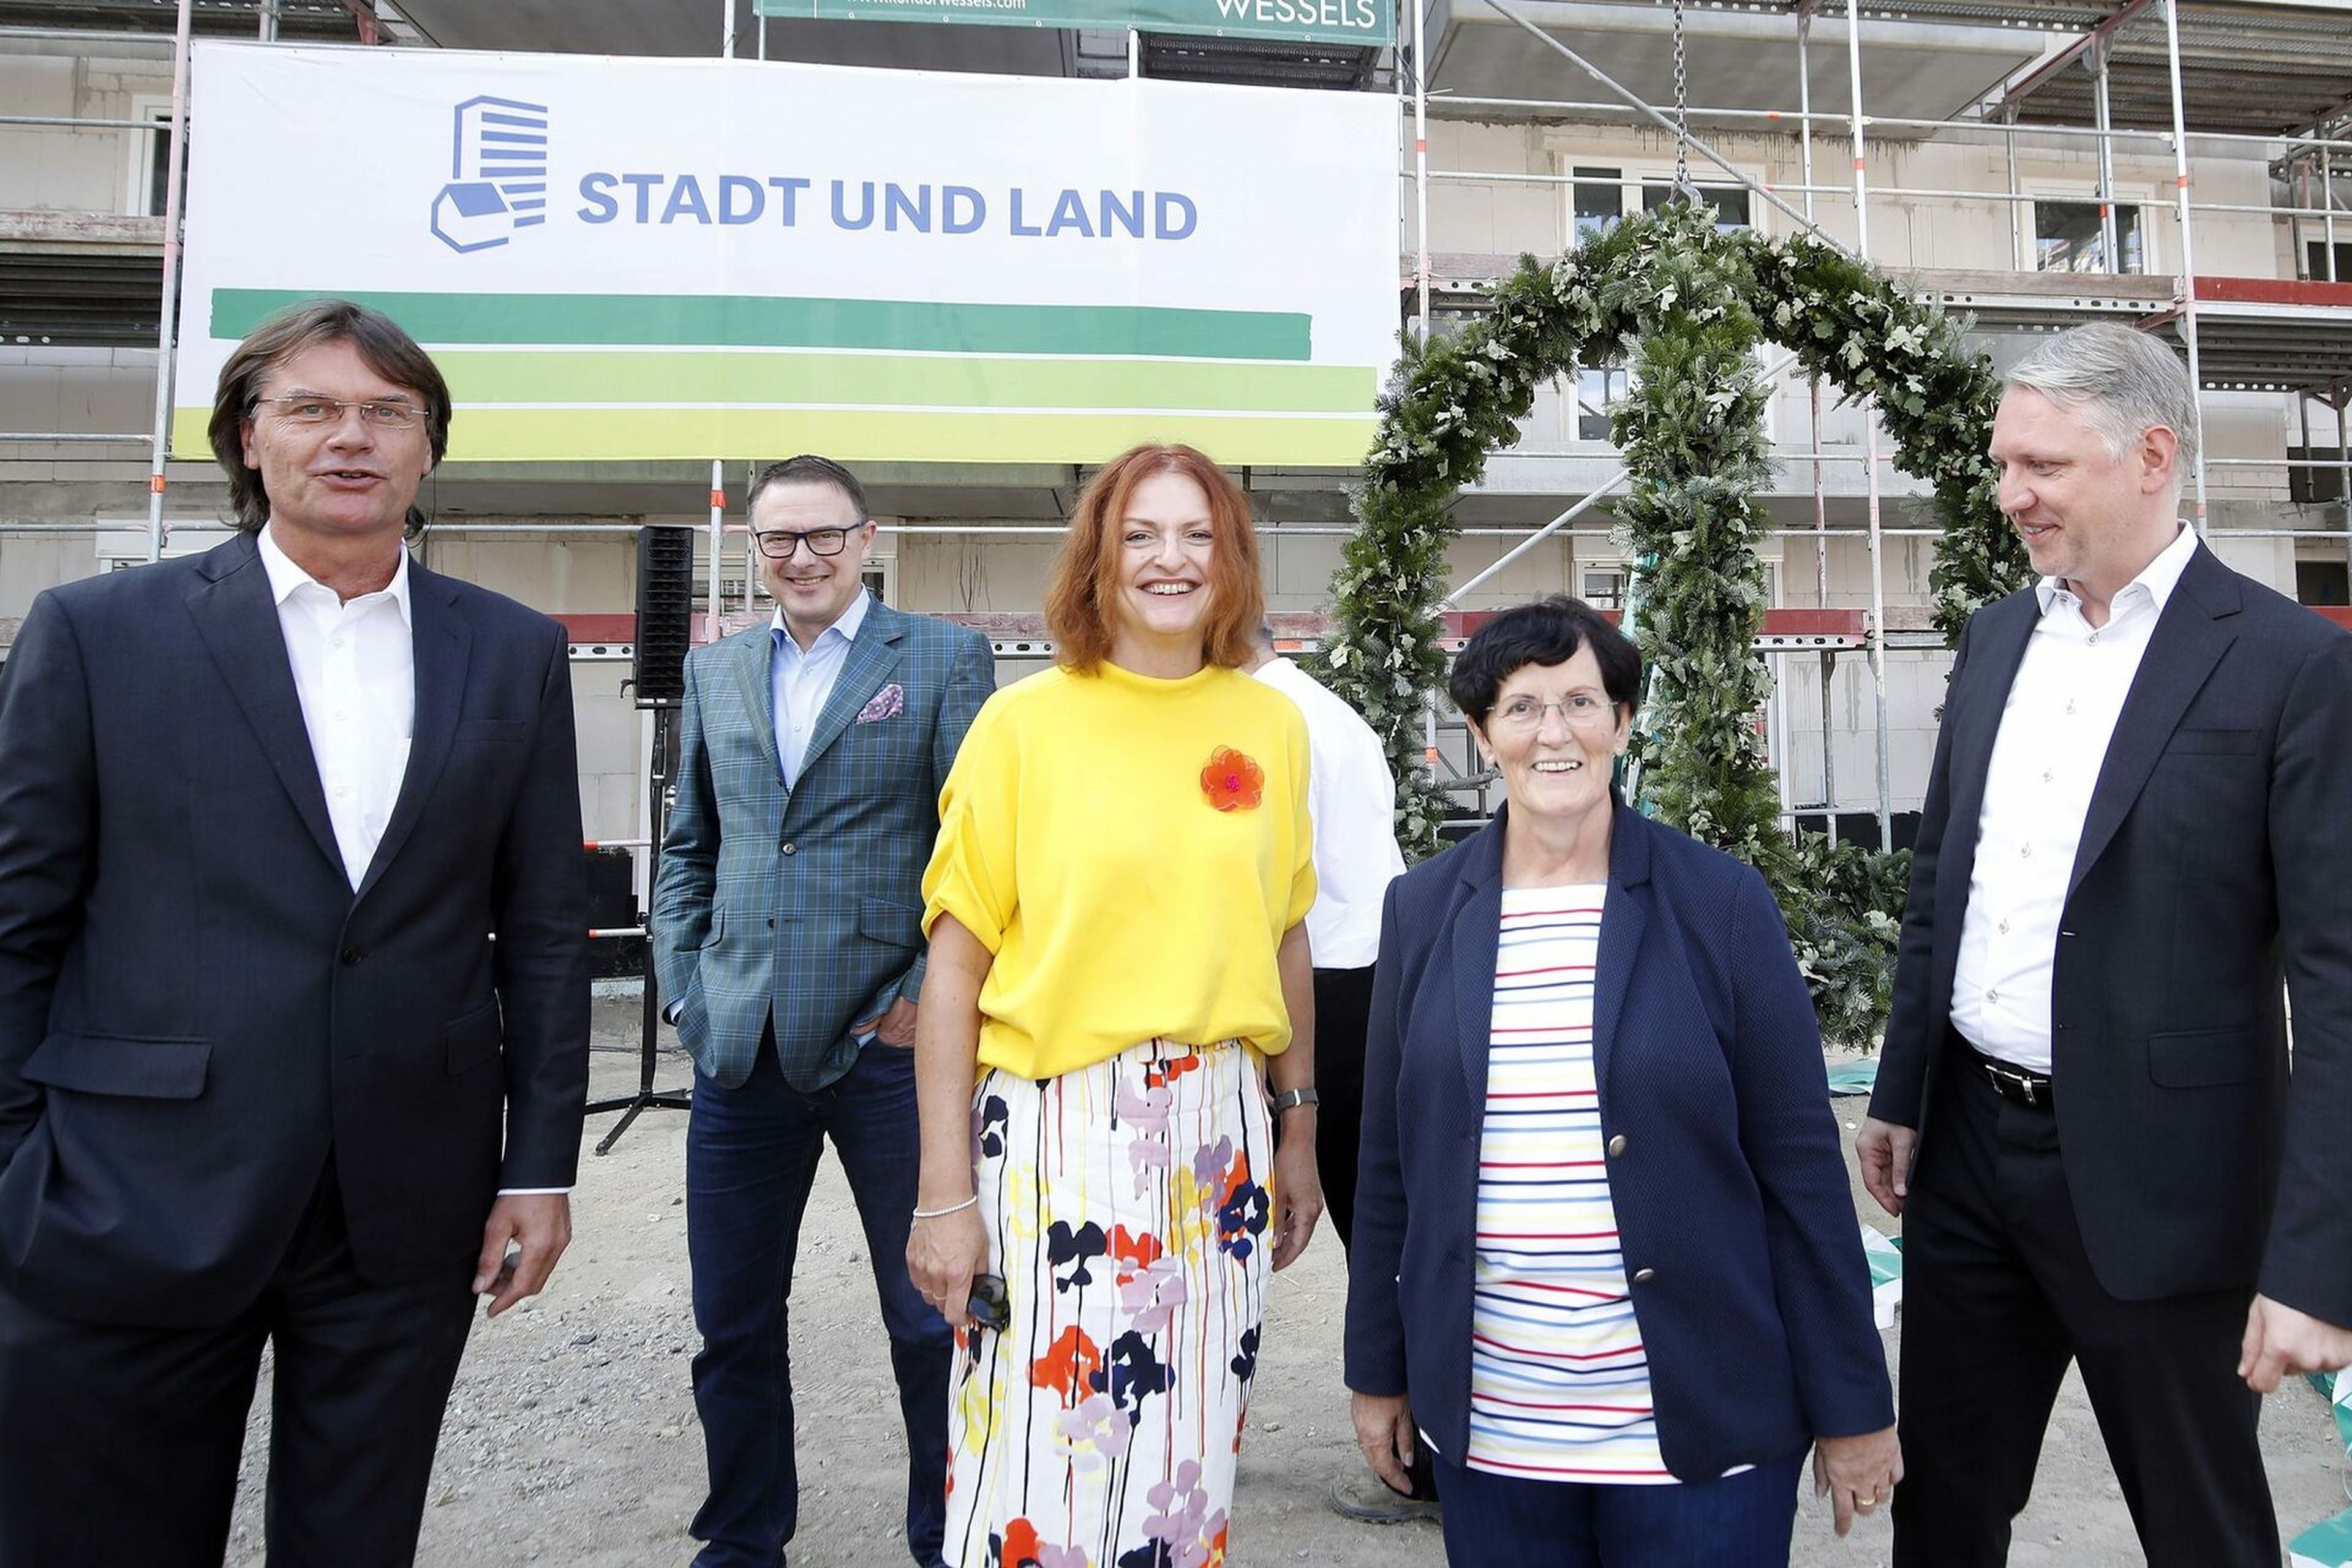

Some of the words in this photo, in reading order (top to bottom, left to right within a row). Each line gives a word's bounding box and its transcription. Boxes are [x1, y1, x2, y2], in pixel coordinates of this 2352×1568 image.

[1215, 0, 1376, 29] WESSELS
[577, 172, 810, 226] STADT
[831, 180, 986, 234] UND
[1011, 188, 1197, 240] LAND
